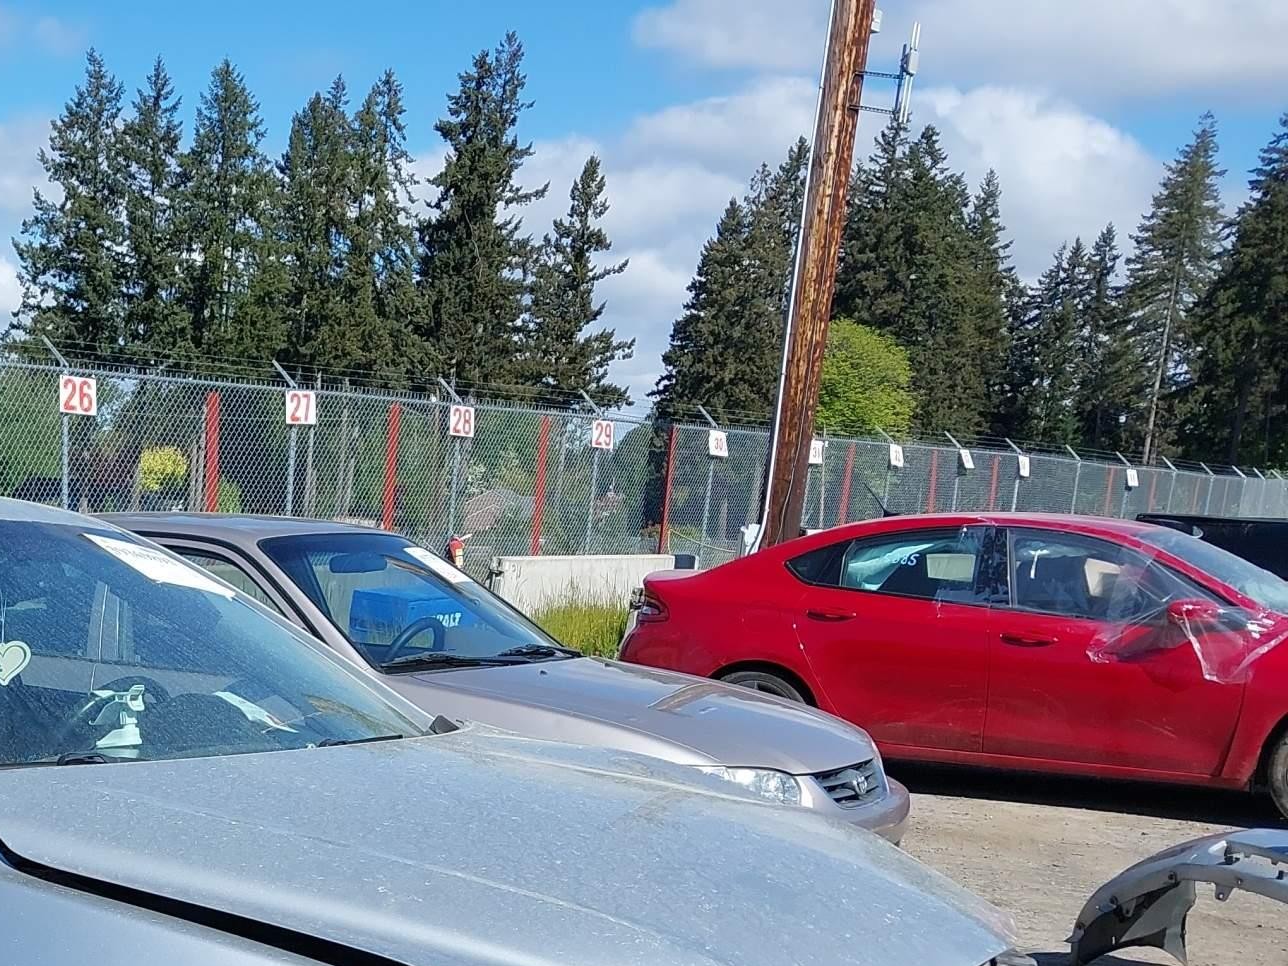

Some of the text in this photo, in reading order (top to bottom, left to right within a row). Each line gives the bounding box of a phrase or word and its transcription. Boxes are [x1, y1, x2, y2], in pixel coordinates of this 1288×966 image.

[62, 377, 94, 413] 26
[289, 392, 312, 423] 27
[452, 407, 472, 436] 28
[594, 421, 613, 447] 29
[713, 437, 725, 451] 30
[812, 446, 821, 458] 31
